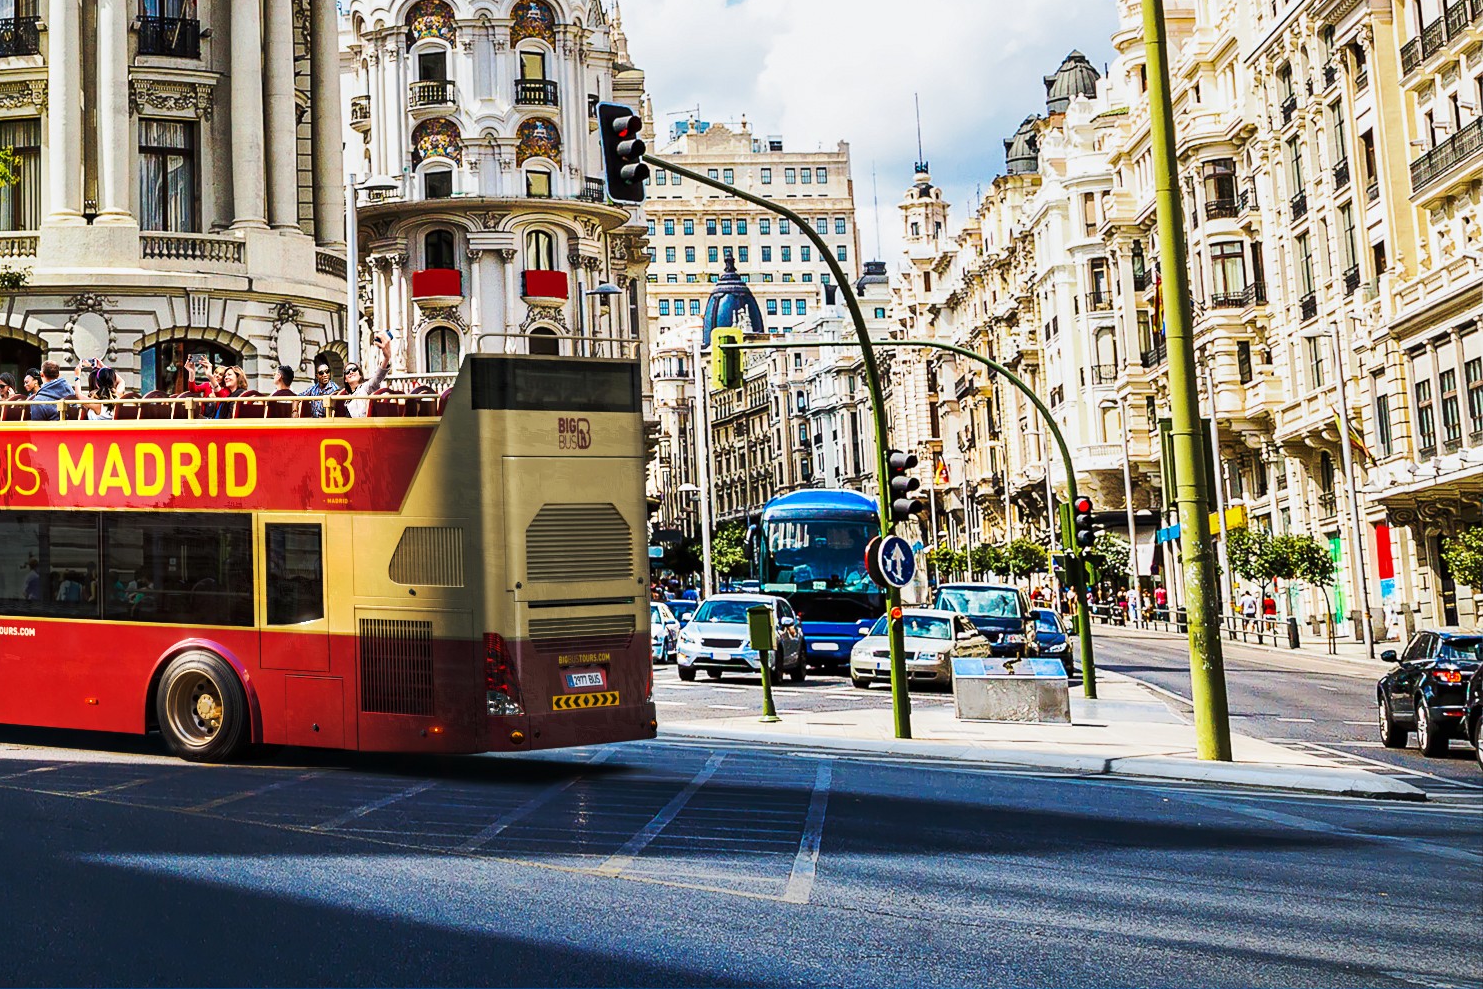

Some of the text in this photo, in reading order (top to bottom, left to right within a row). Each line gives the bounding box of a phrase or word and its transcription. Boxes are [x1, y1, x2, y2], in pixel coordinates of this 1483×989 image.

[558, 417, 577, 434] BIG
[558, 434, 577, 450] BUS
[57, 442, 258, 498] MADRID
[558, 653, 611, 665] BIGBUSTOURS.COM
[587, 674, 601, 685] BUS
